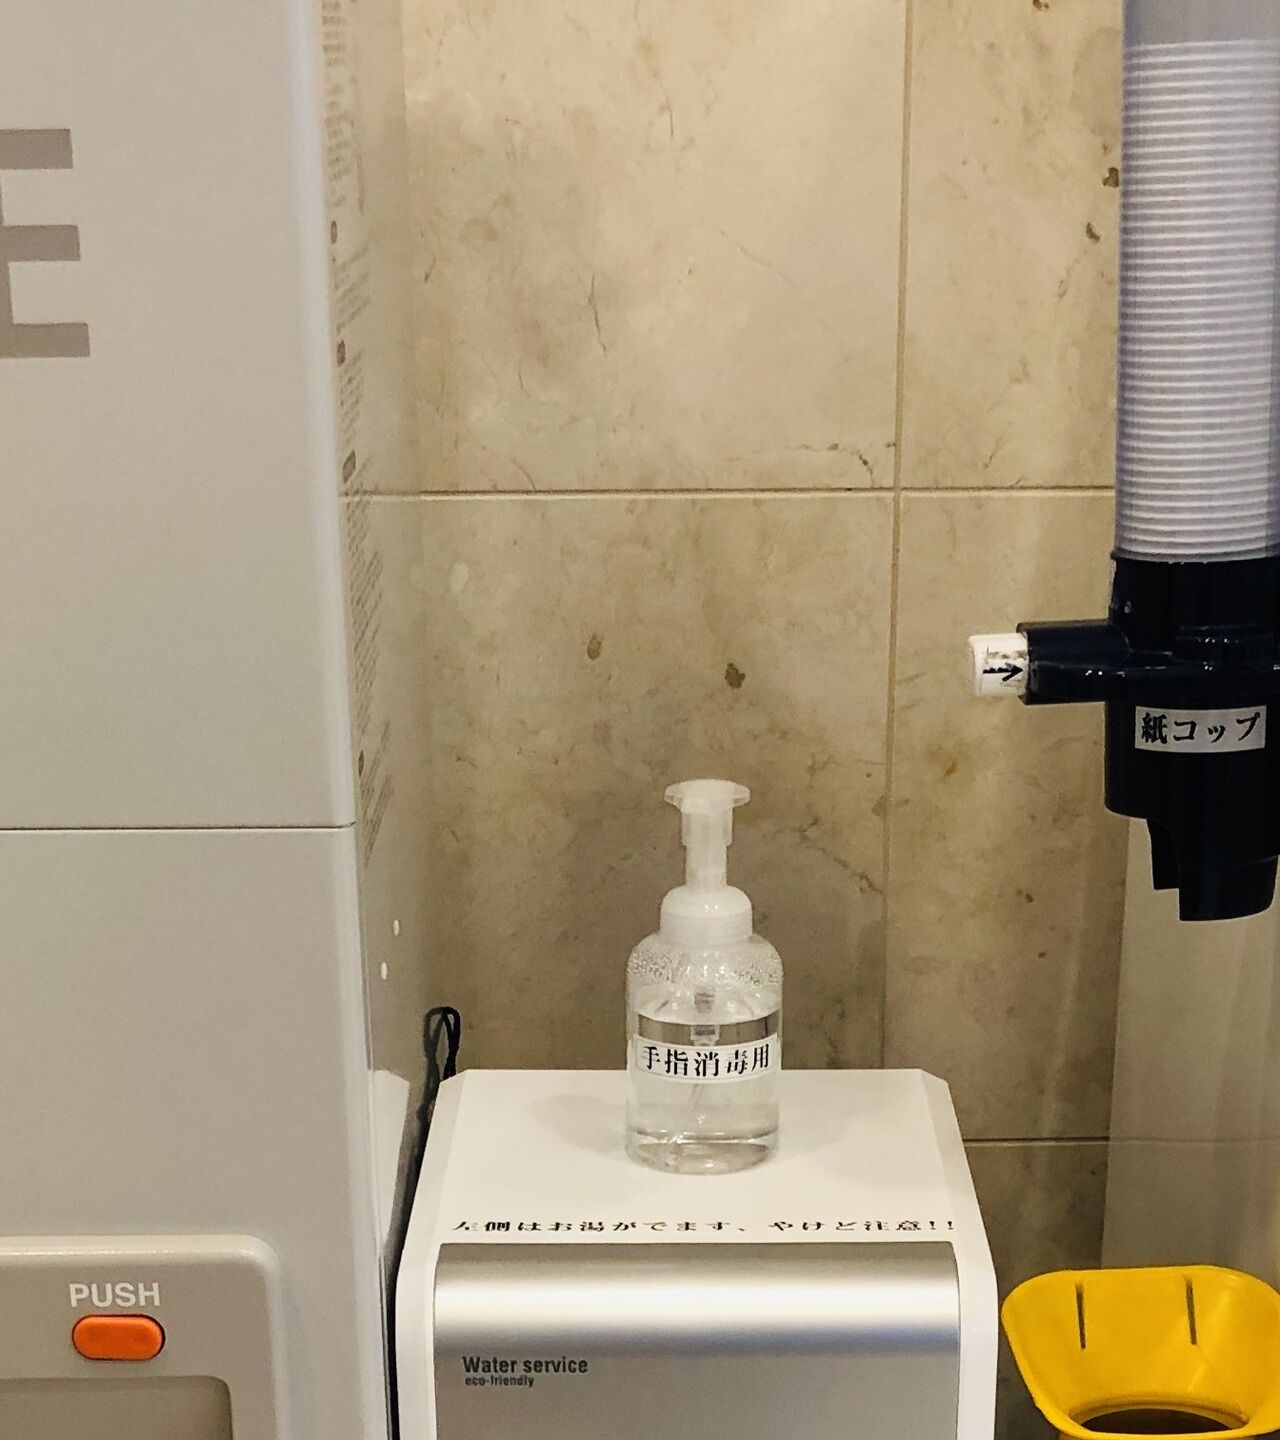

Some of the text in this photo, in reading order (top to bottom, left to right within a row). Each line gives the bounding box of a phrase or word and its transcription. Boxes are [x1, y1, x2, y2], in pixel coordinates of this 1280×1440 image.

[1141, 710, 1261, 746] 紙コップ
[642, 1043, 770, 1078] 手指消毒用
[69, 1282, 162, 1308] PUSH
[462, 1355, 589, 1375] Water service
[465, 1375, 536, 1388] eco-friendly
